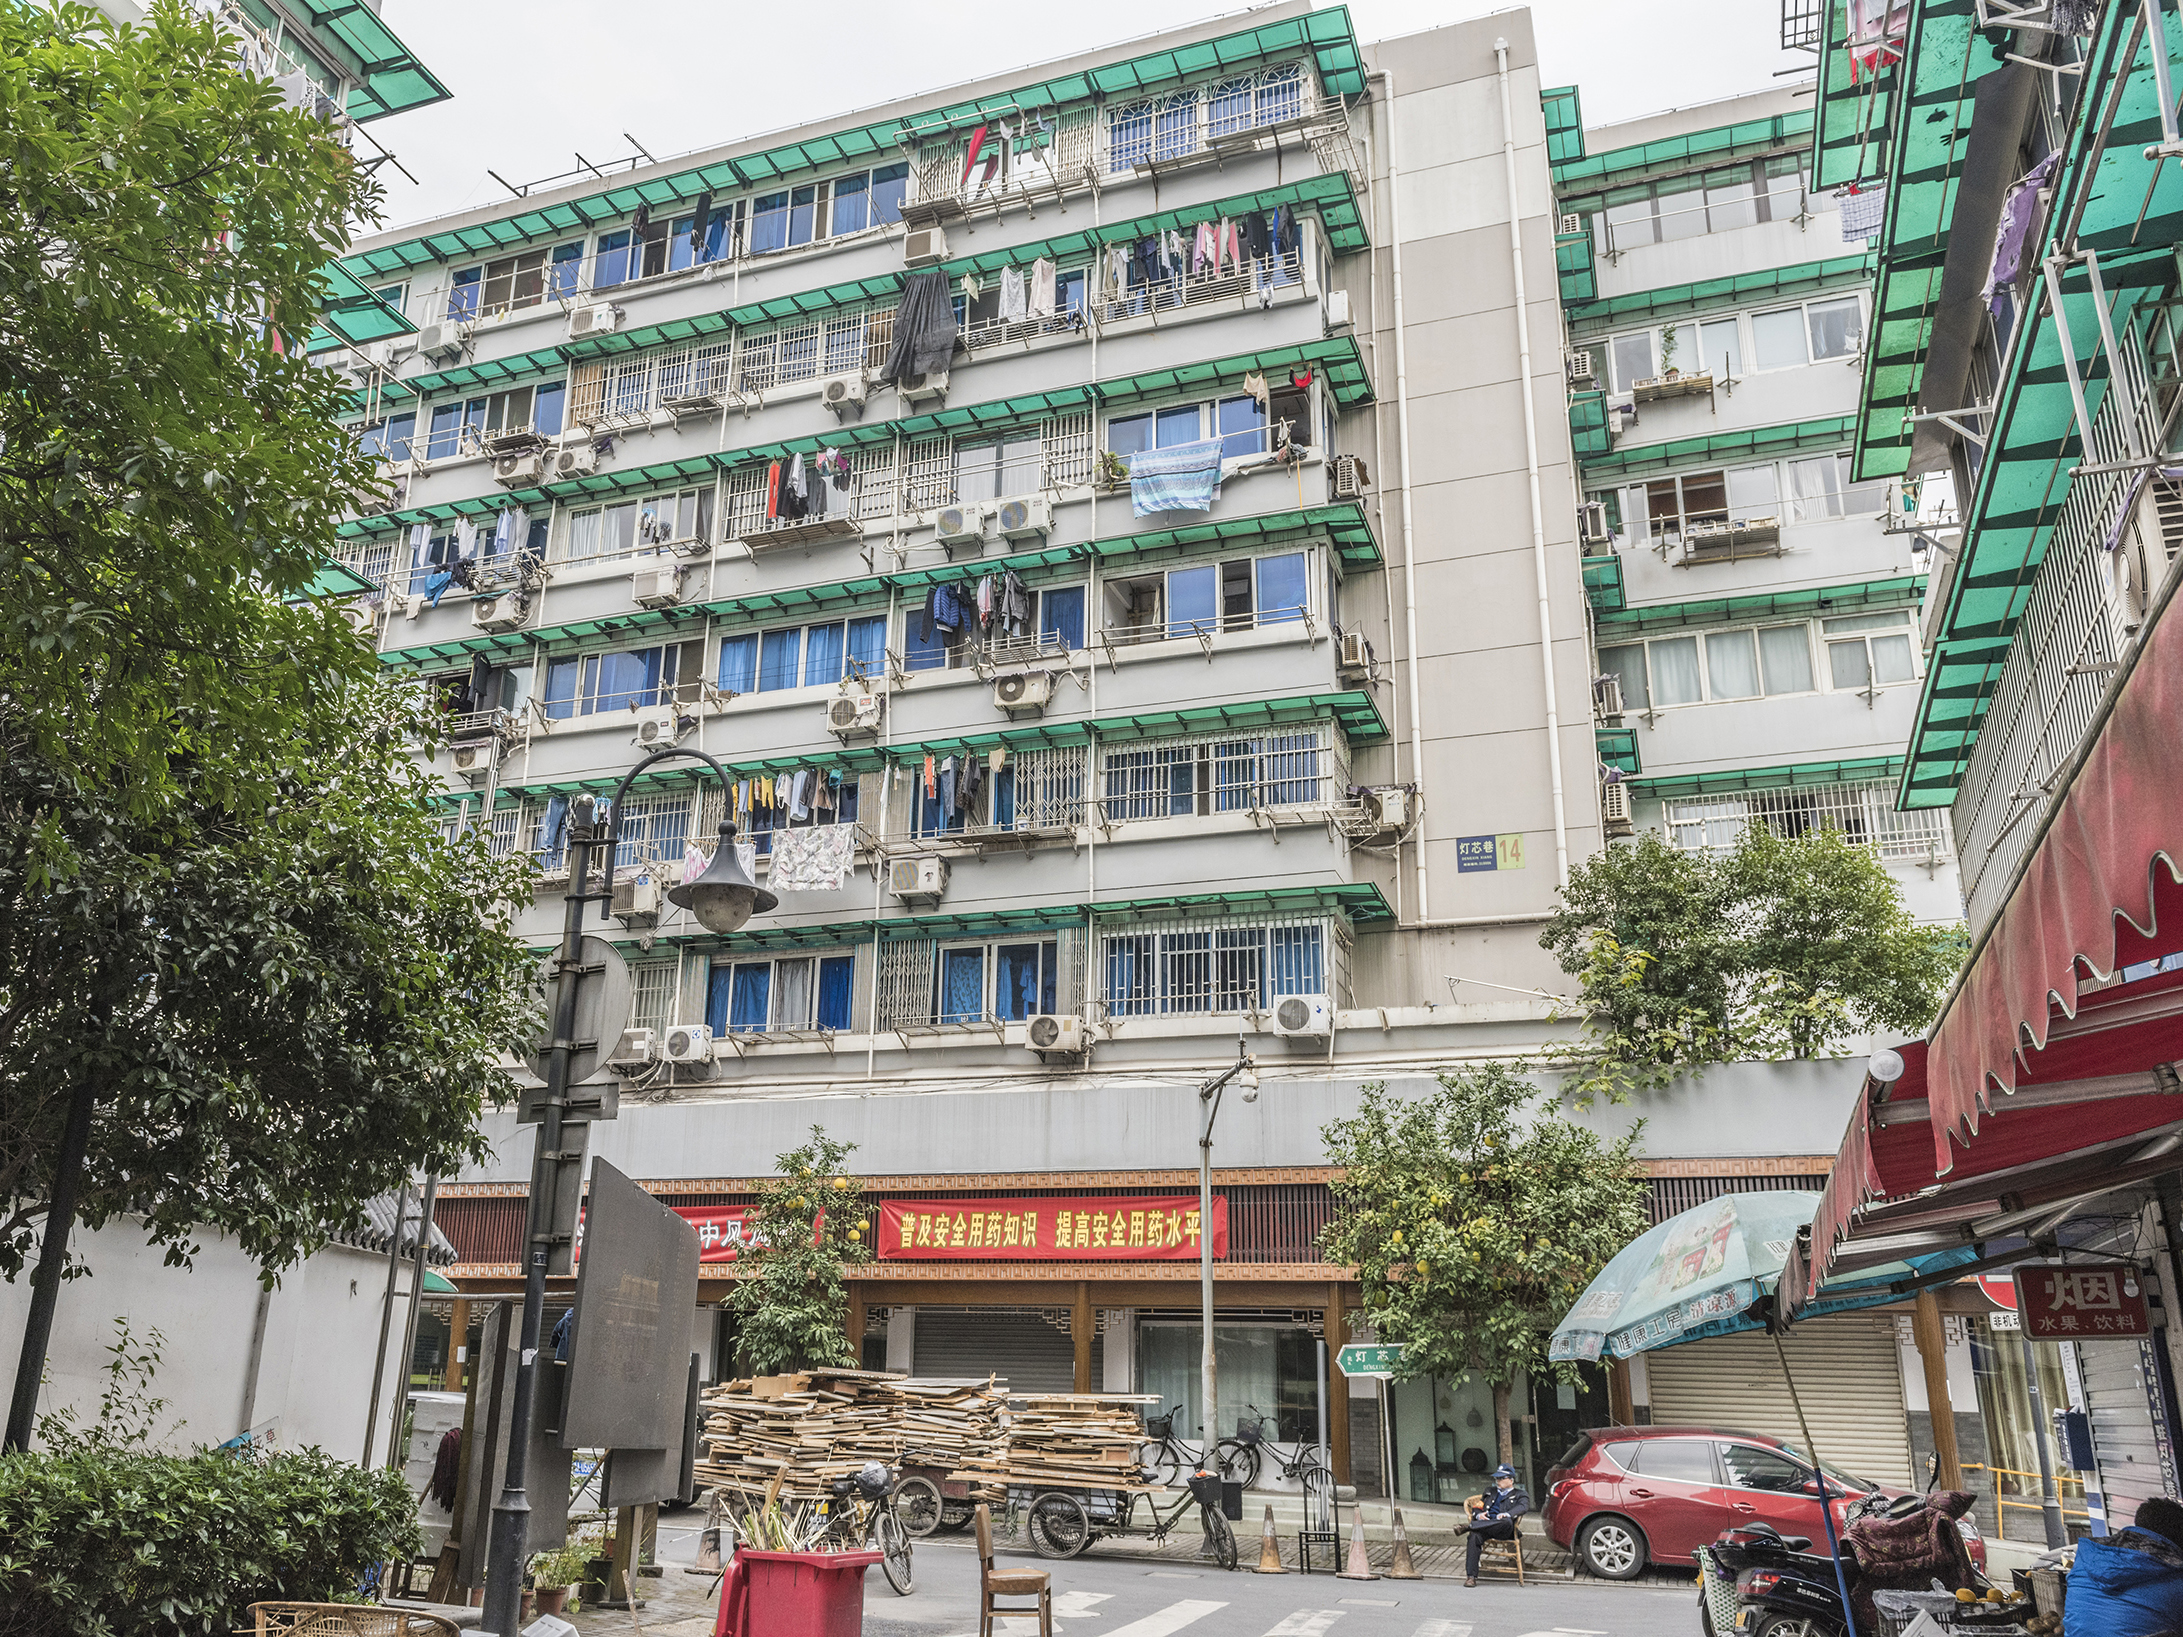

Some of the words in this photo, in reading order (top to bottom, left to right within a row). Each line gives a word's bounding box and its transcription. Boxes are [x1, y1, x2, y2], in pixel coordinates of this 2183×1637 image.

[1460, 840, 1494, 855] 灯芯巷
[1499, 839, 1521, 863] 14
[900, 1212, 1038, 1248] 普及安全用药知识
[1055, 1209, 1201, 1249] 提高安全用药水平
[2045, 1271, 2121, 1311] 烟
[1616, 1309, 1683, 1351] 健康工房
[2037, 1314, 2136, 1331] 水果、饮料
